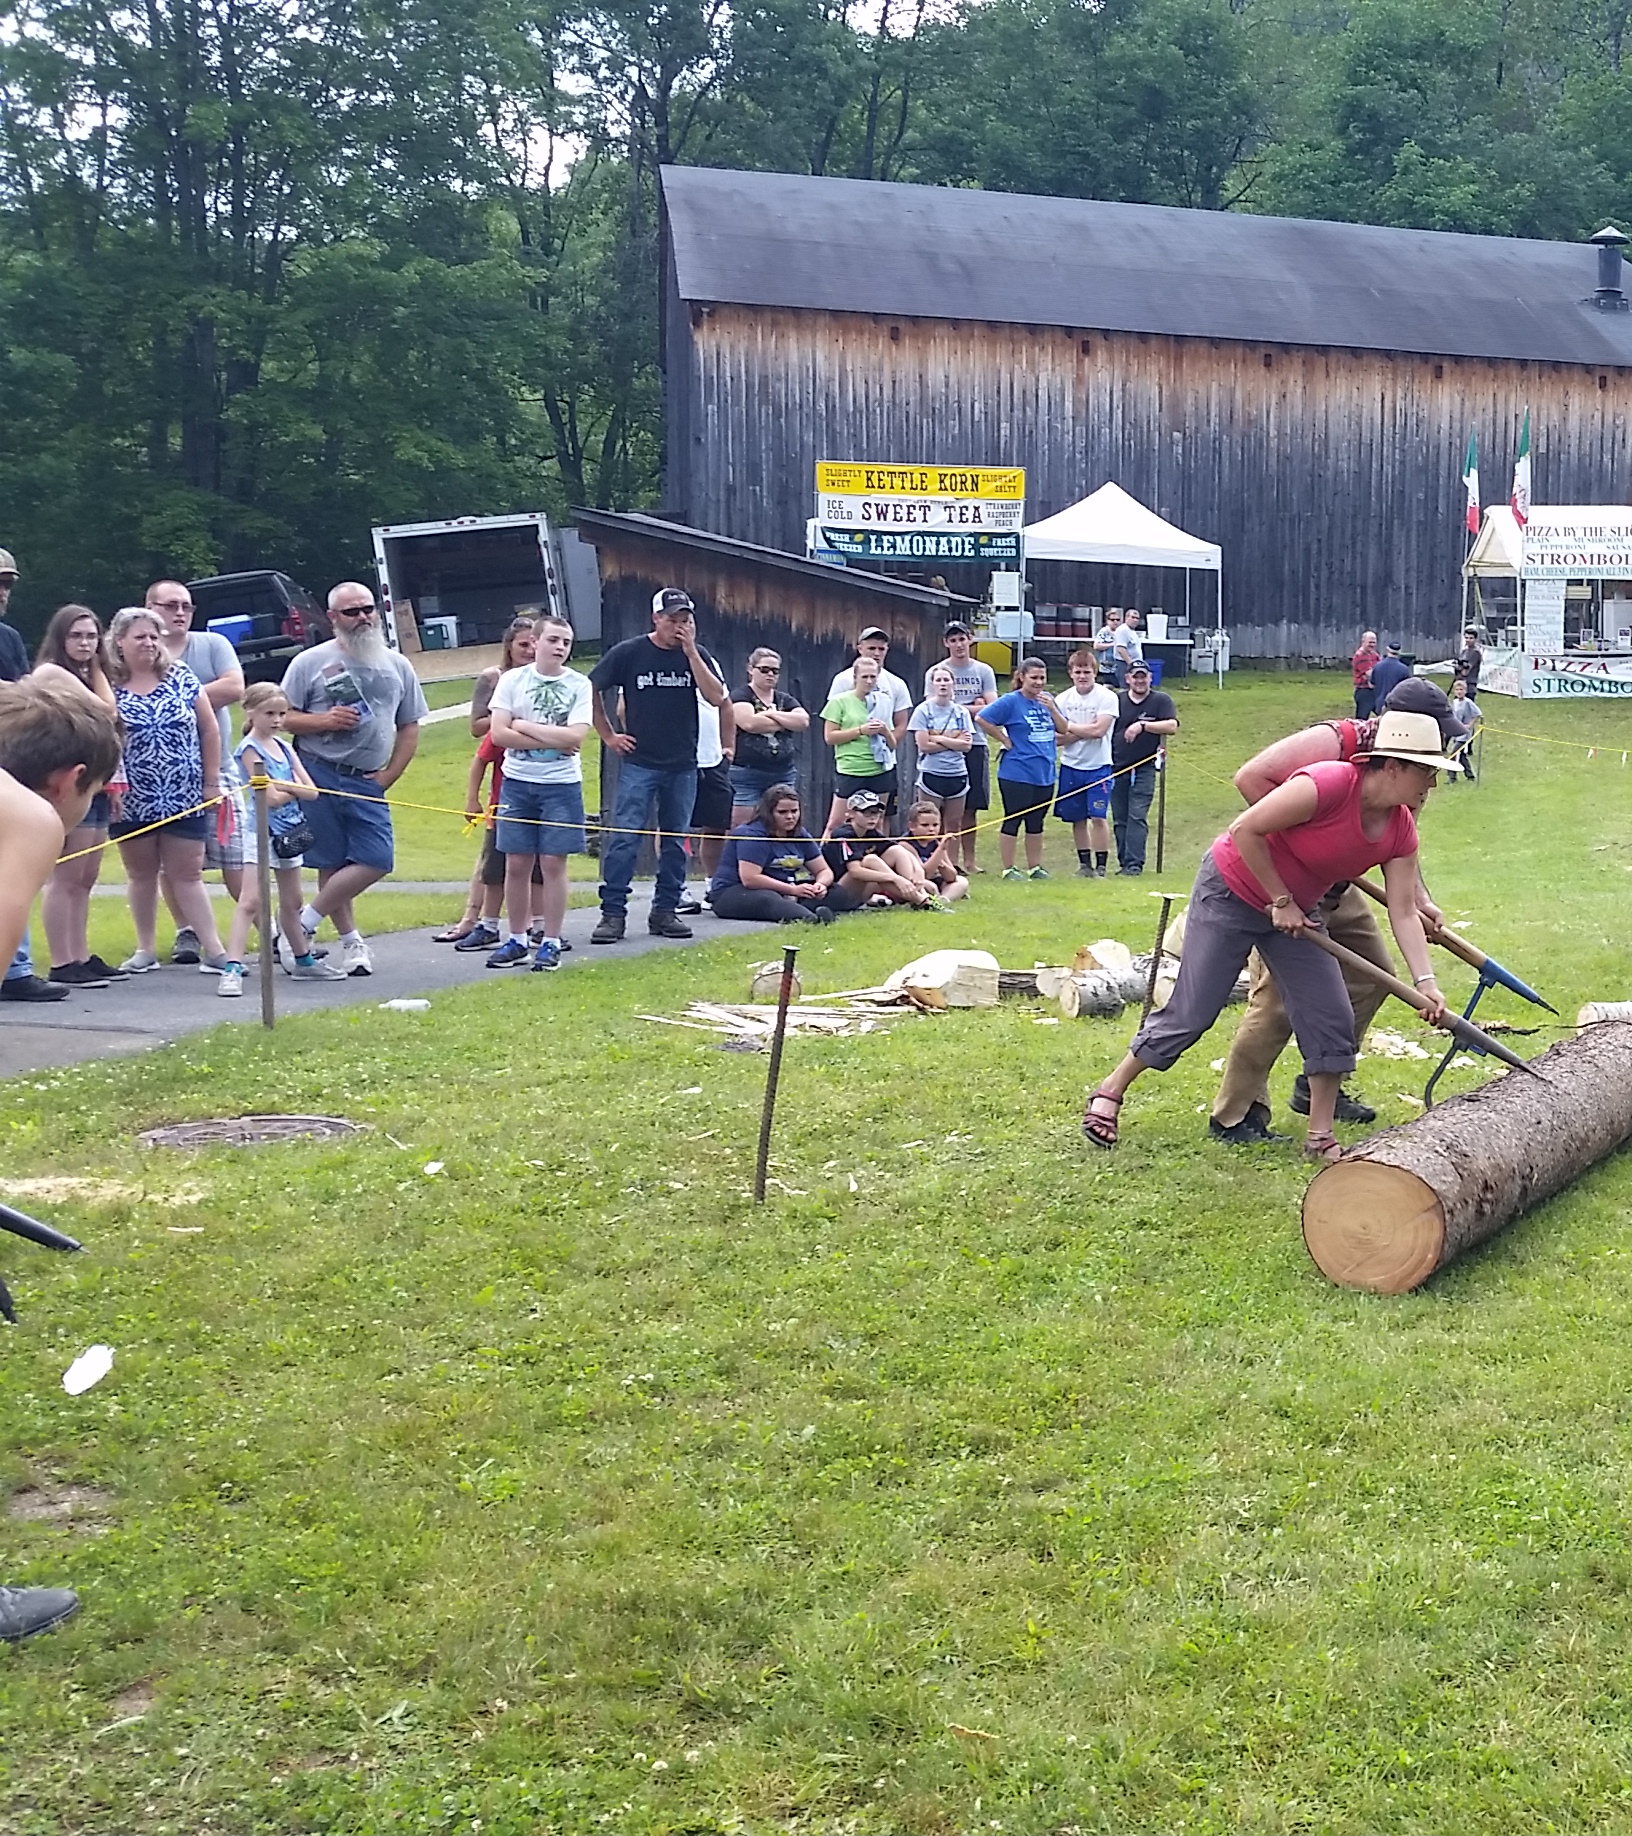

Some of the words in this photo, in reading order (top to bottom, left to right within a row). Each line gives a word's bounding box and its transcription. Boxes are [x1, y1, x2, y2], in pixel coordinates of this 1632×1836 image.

[826, 469, 861, 477] SLIGHTLY
[865, 470, 928, 491] KETTLE
[938, 472, 980, 492] KORN
[826, 479, 850, 487] SWEET
[995, 485, 1017, 493] SALTY
[827, 500, 844, 509] ICE
[827, 510, 852, 519] COLD
[862, 502, 931, 523] SWEET
[944, 505, 983, 524] TEA
[1525, 526, 1560, 537] PIZZA
[1563, 526, 1576, 537] BY
[1583, 526, 1607, 537] THE
[869, 534, 976, 557] LEMONADE
[992, 538, 1016, 546] FRESH
[980, 548, 1016, 557] SQUEEZED
[1532, 657, 1611, 674] PIZZA
[637, 671, 654, 689] got
[656, 671, 691, 687] timber?
